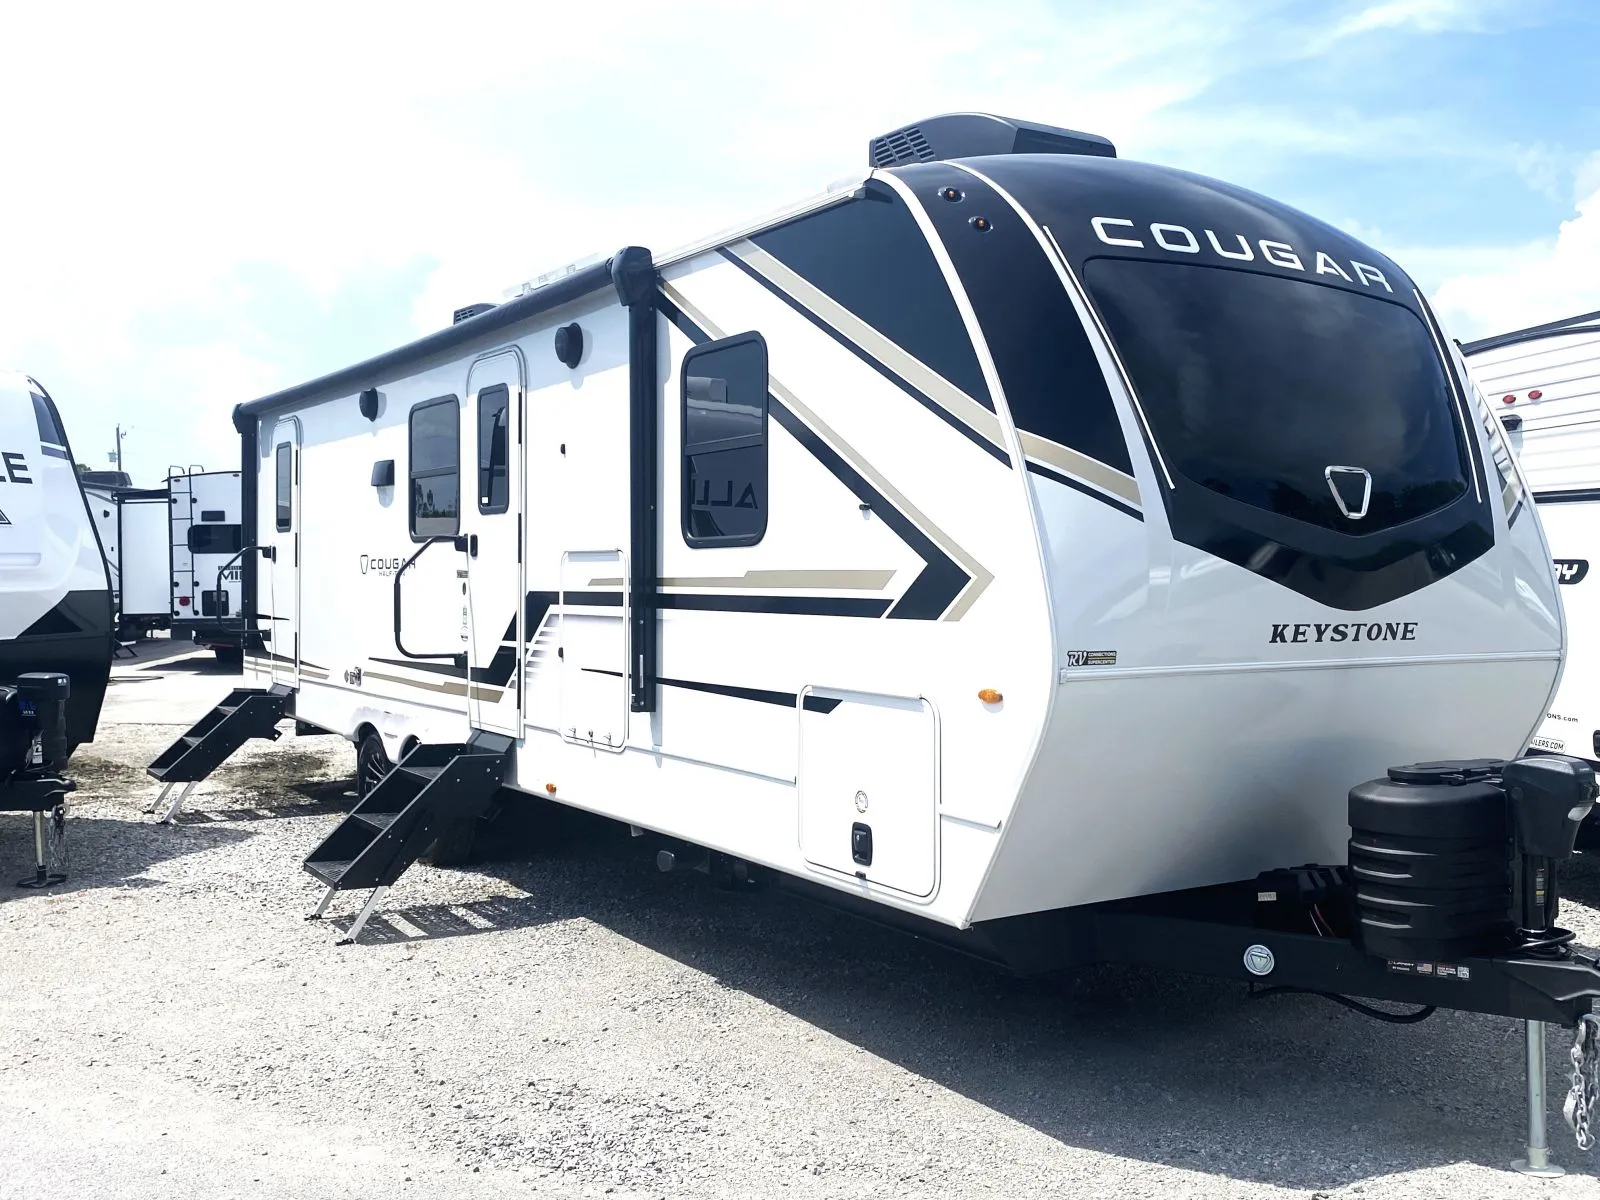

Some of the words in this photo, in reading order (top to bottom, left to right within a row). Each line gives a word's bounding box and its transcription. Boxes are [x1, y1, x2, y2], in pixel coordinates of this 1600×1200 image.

[1089, 216, 1394, 293] COUGAR
[1268, 622, 1419, 644] KEYSTONE
[1067, 651, 1088, 666] RV
